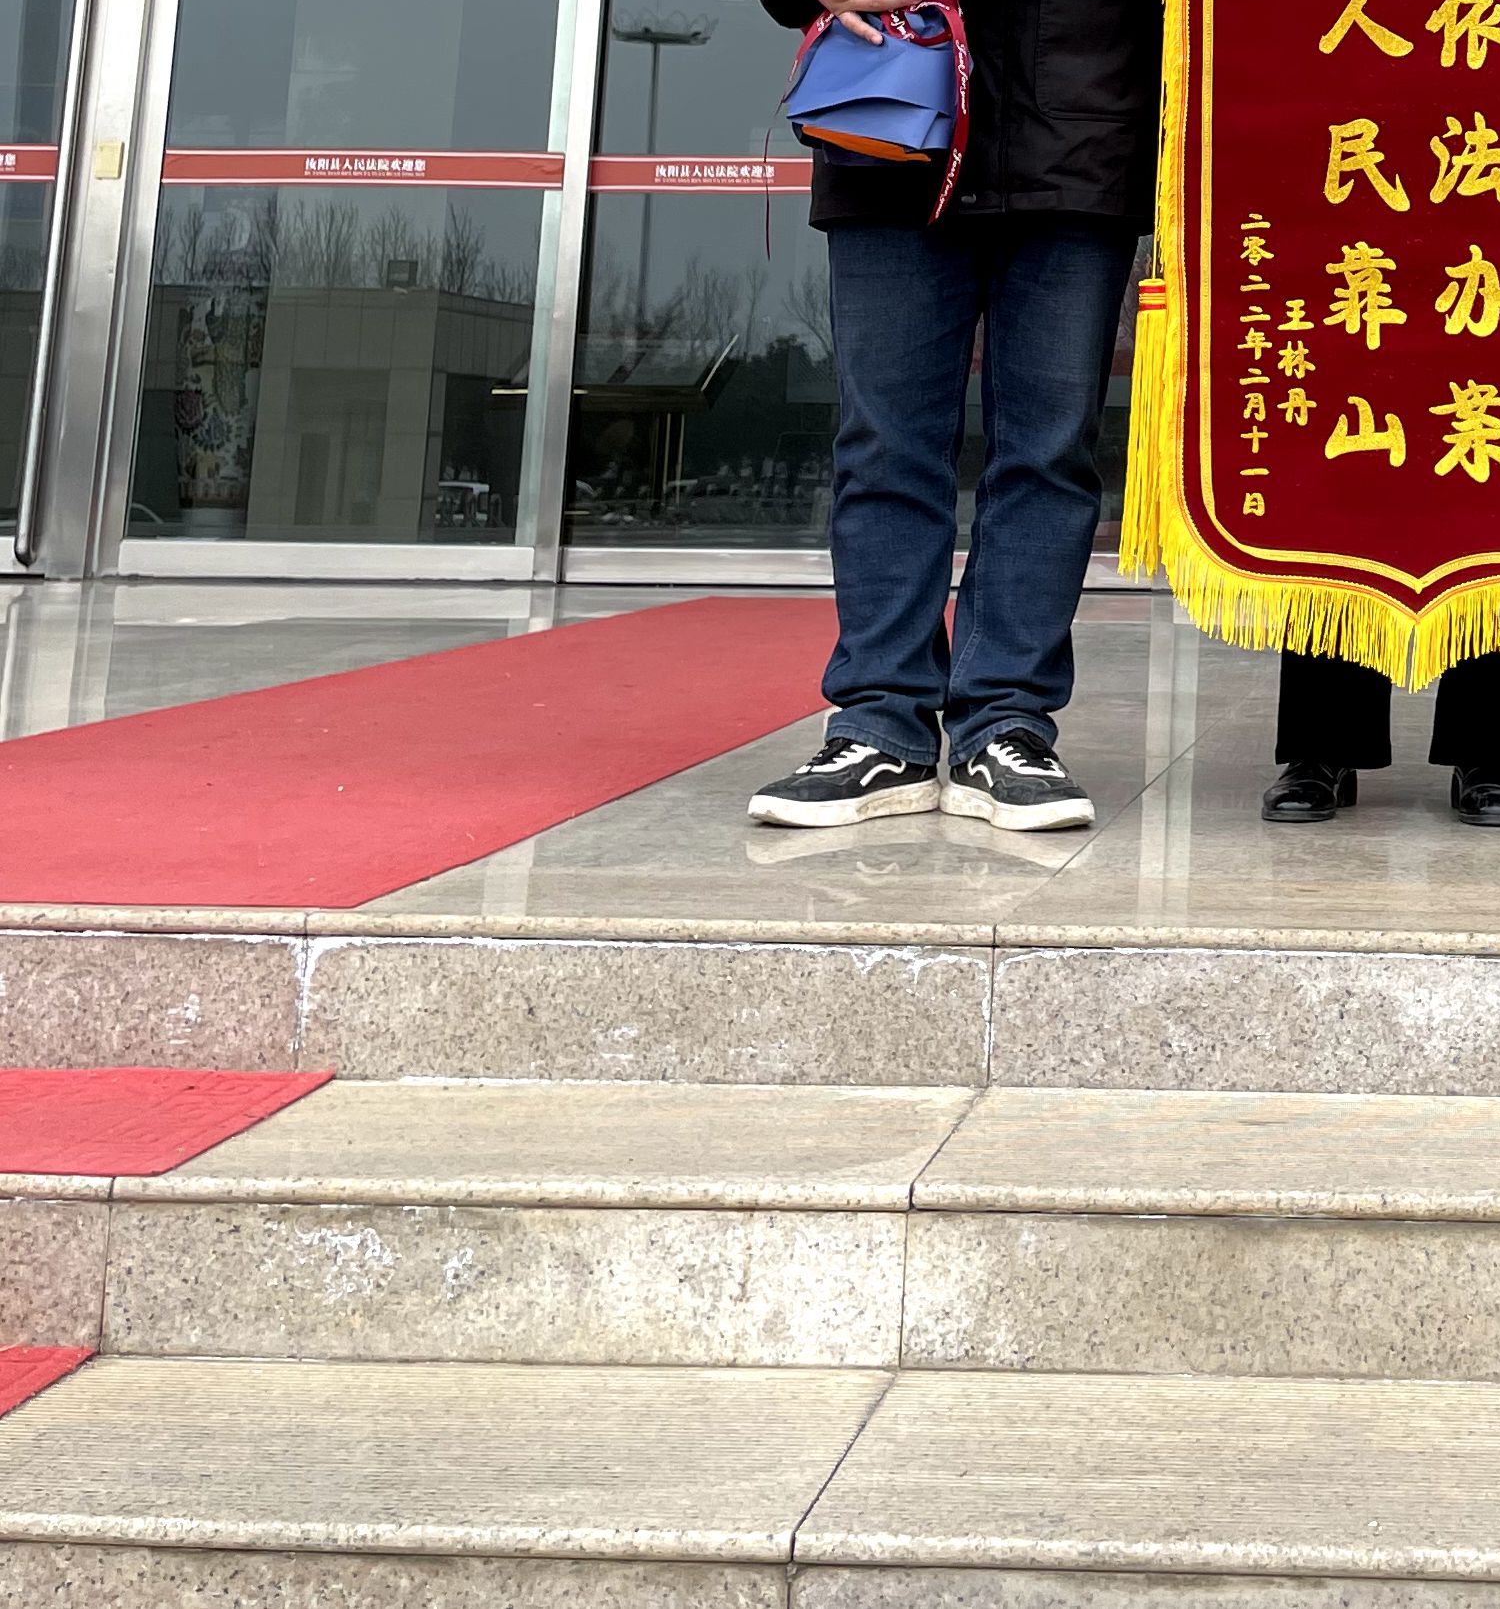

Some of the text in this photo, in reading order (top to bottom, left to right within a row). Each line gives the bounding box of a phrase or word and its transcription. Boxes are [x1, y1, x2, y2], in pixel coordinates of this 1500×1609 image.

[304, 156, 427, 172] 汝阳县人民法院欢迎您
[654, 164, 775, 179] 汝阳县人民法院欢迎您
[1237, 213, 1275, 517] 二零二二年二月十一日
[1276, 298, 1317, 427] 王林丹
